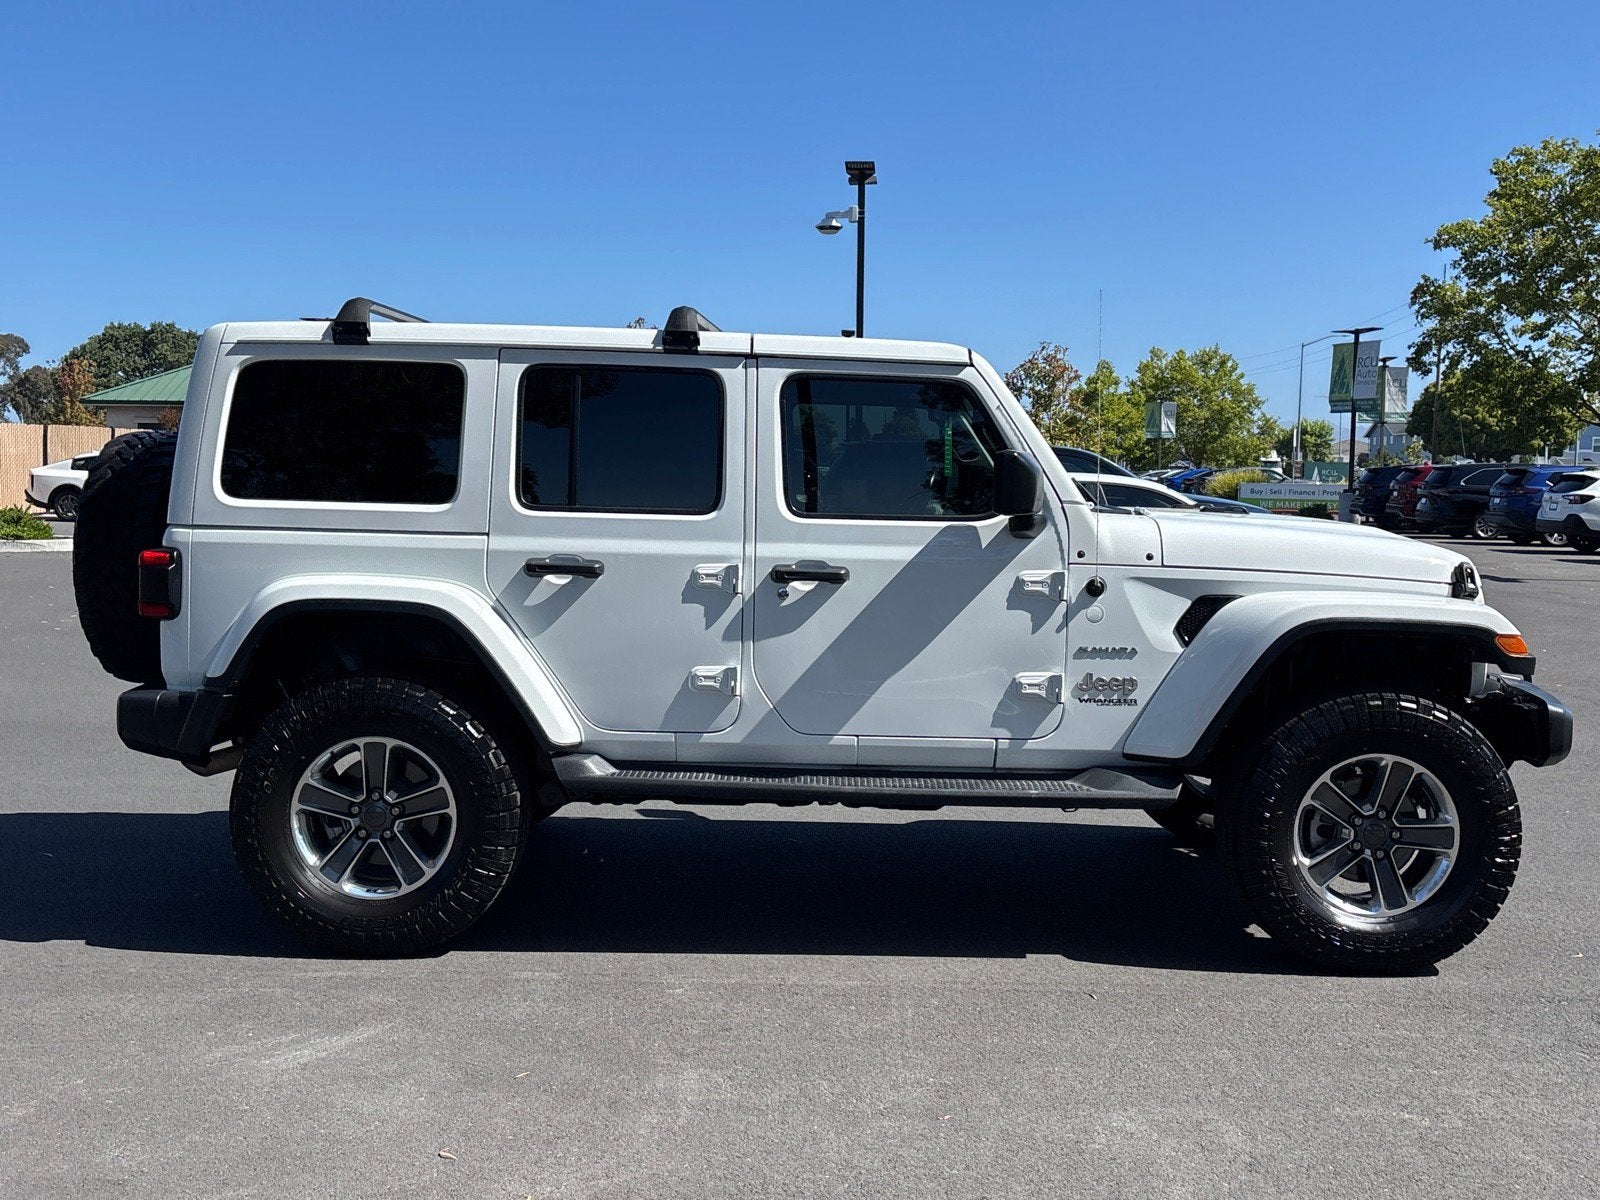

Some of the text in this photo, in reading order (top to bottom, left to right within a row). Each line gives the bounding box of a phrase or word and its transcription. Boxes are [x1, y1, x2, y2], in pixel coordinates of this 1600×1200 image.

[1357, 356, 1378, 368] RCU
[1356, 369, 1378, 379] Auto
[1250, 487, 1263, 496] Buy
[1288, 488, 1316, 496] Finance
[1260, 500, 1275, 508] WE
[1276, 501, 1301, 509] MAKE
[1077, 672, 1138, 696] Jeep
